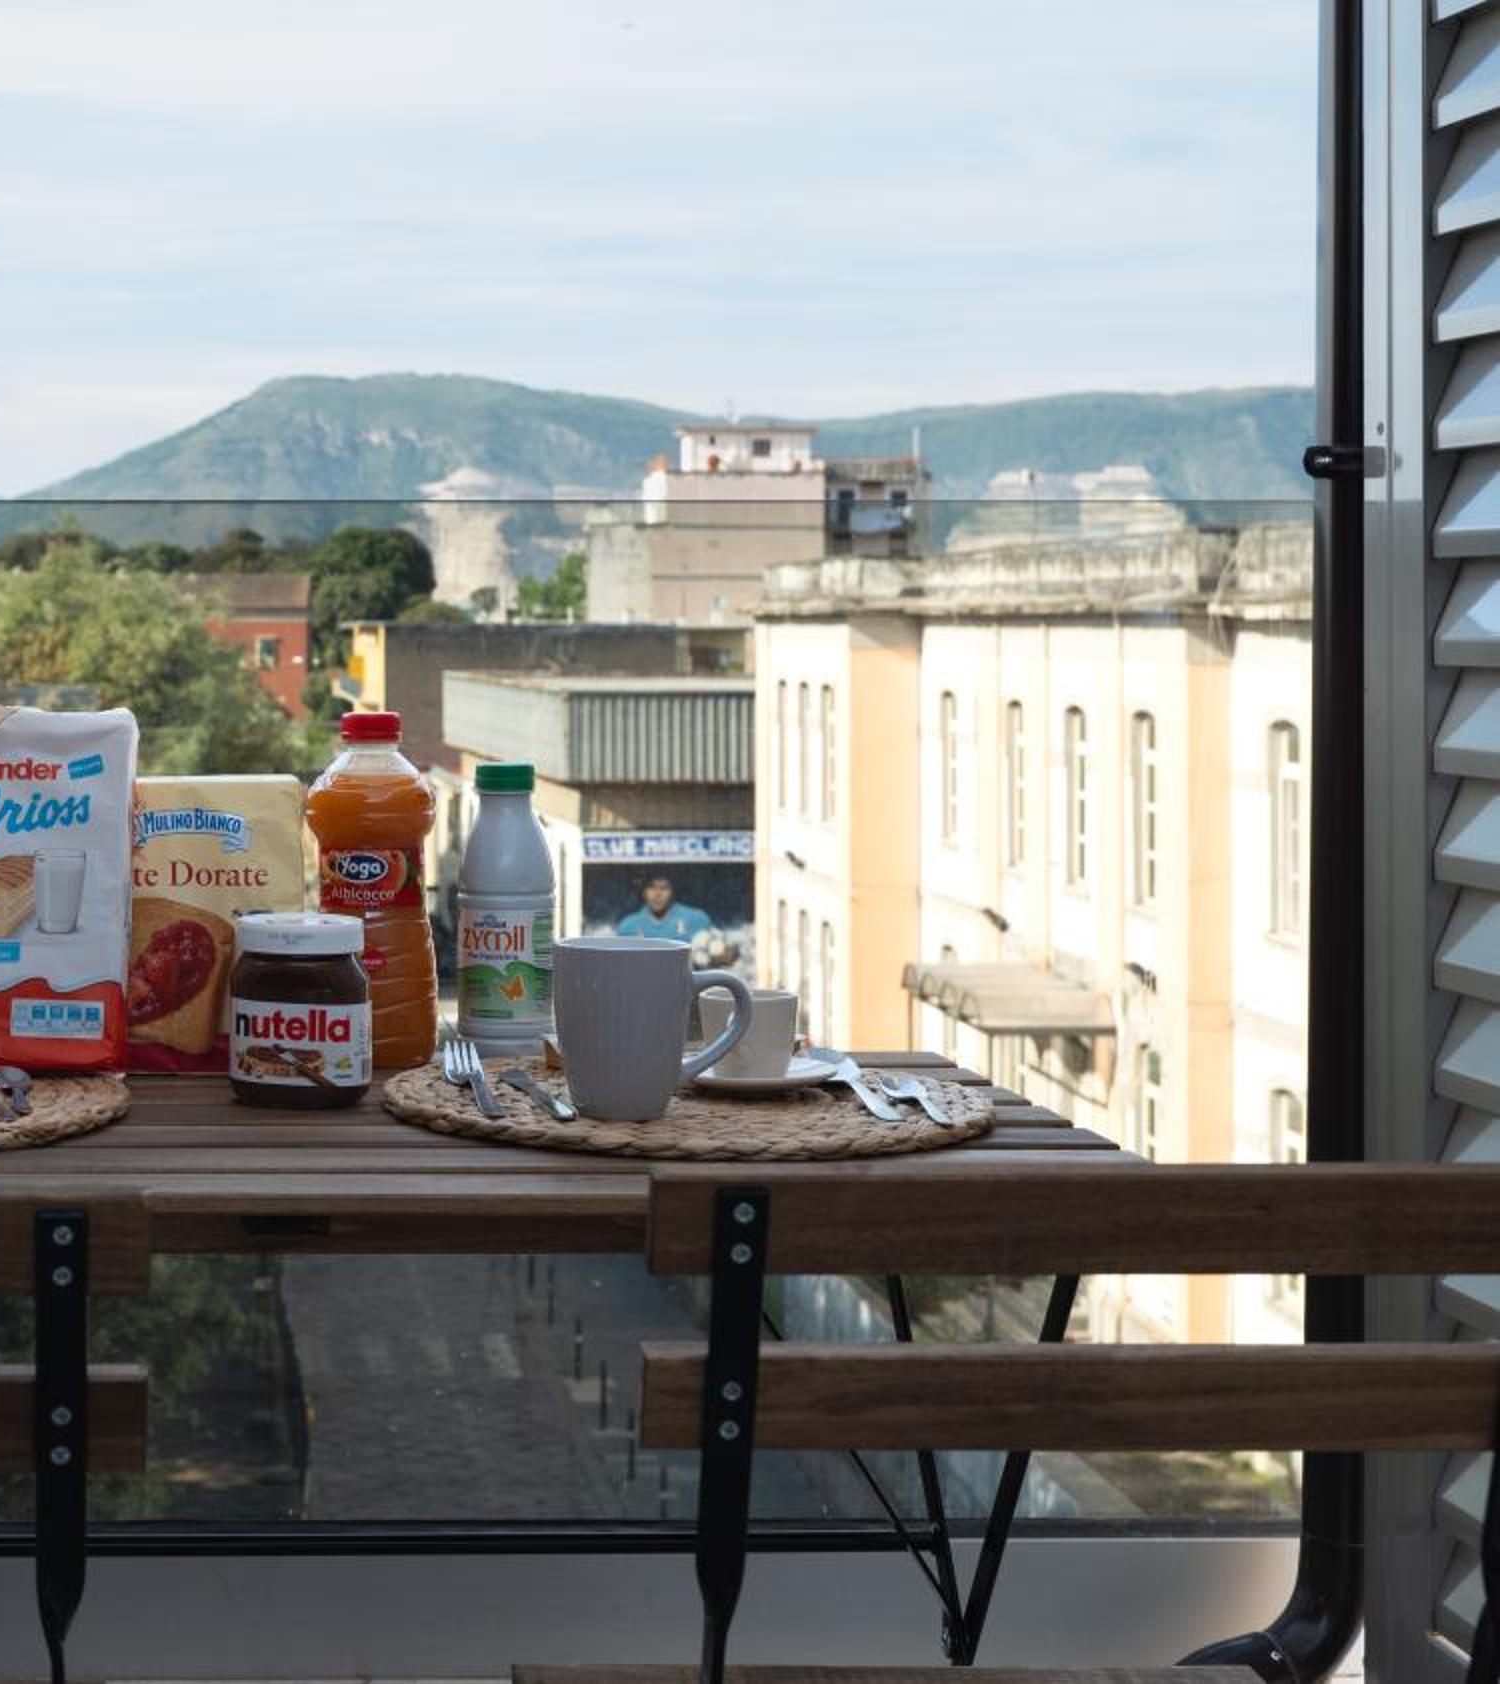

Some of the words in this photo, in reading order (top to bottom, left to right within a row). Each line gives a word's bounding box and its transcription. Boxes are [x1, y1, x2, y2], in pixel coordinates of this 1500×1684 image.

[142, 811, 192, 834] MULINO
[195, 808, 242, 834] BIANCO
[168, 859, 269, 888] Dorate
[339, 855, 382, 880] Yoga
[235, 1009, 351, 1043] nutella
